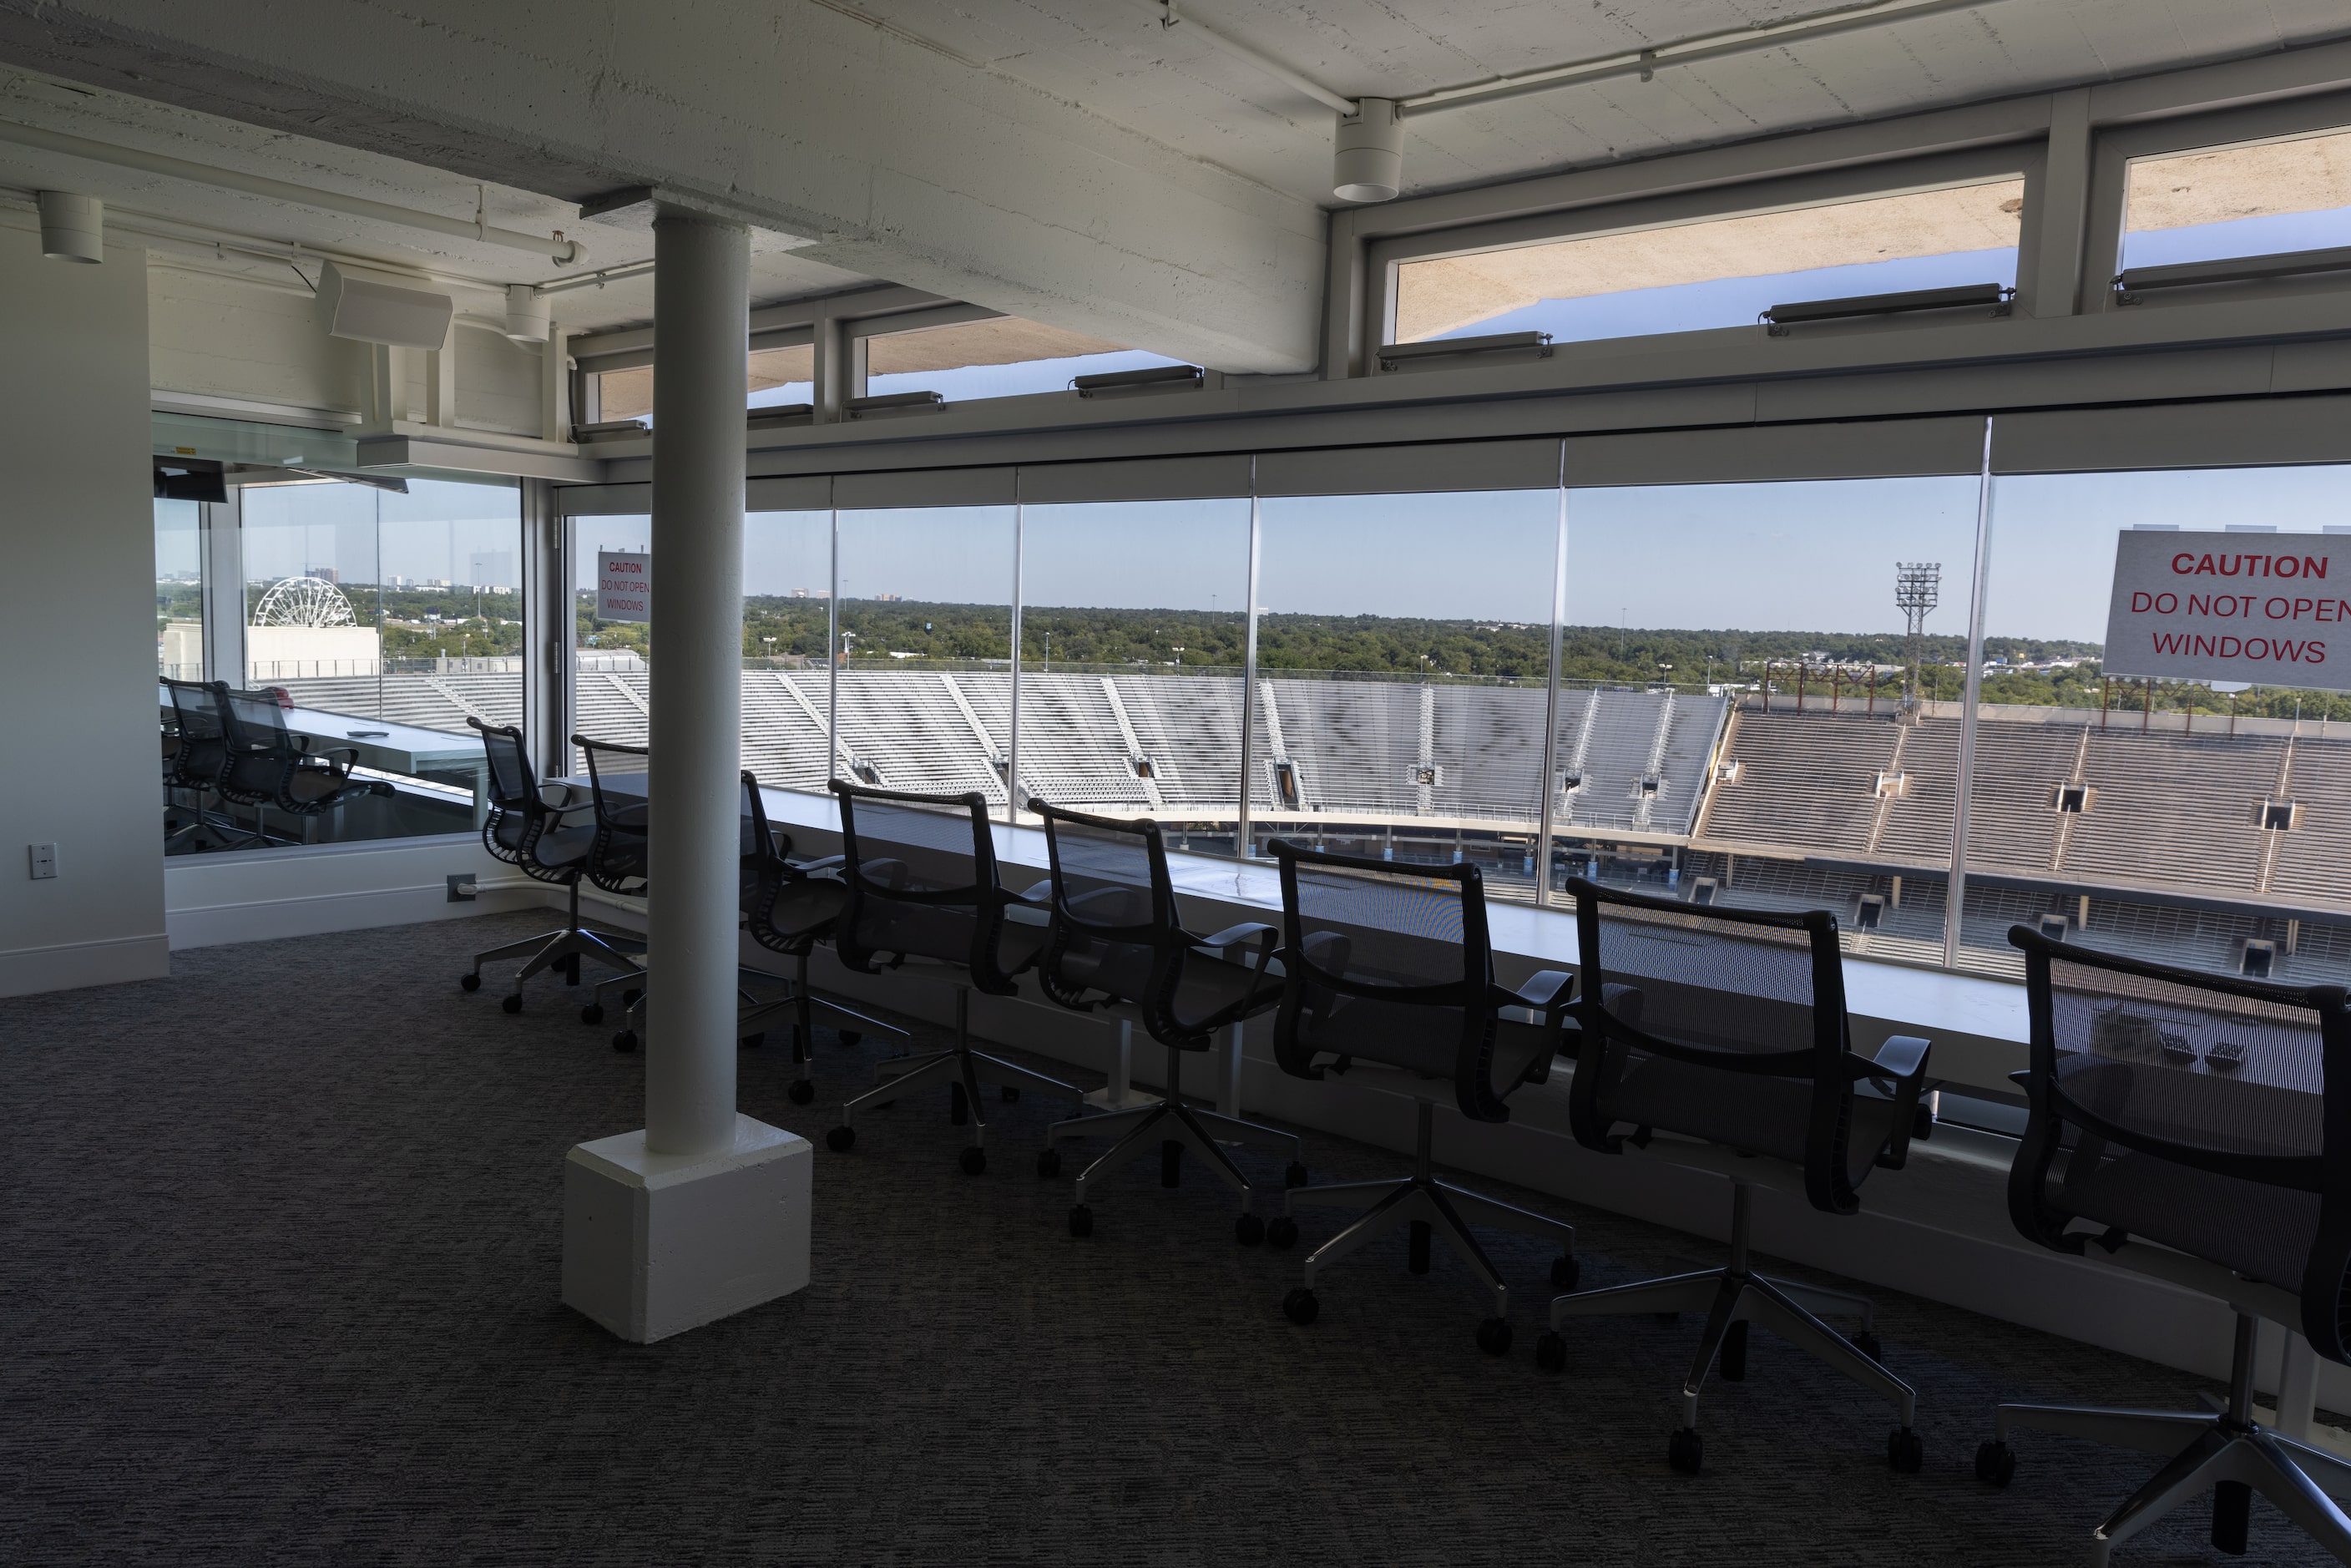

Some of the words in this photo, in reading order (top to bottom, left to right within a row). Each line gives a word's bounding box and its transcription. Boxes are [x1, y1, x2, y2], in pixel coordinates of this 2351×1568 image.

[609, 562, 641, 574] CAUTION
[2172, 553, 2328, 579] CAUTION
[601, 579, 612, 590] DO
[614, 580, 628, 591] NOT
[629, 581, 650, 593] OPEN
[607, 599, 644, 611] WINDOWS
[2131, 591, 2178, 615] DO
[2187, 594, 2257, 618] NOT
[2264, 597, 2351, 622] OPEN
[2152, 632, 2327, 664] WINDOWS
